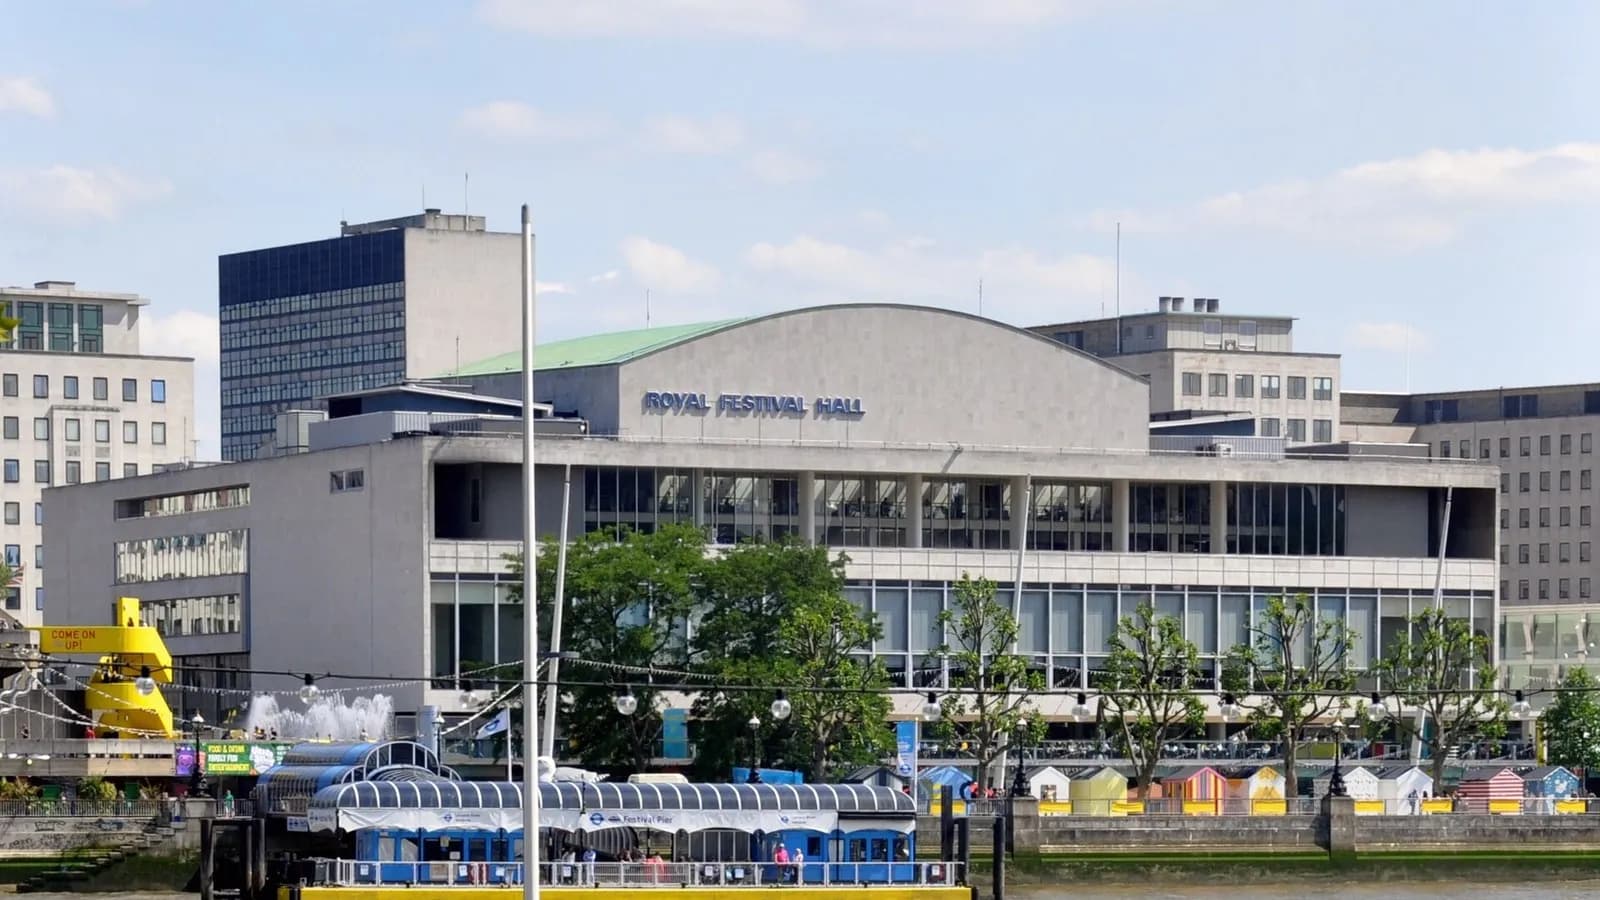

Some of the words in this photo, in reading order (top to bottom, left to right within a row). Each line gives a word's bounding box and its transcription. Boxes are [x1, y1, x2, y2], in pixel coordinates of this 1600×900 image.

[643, 391, 709, 413] ROYAL
[718, 393, 808, 415] FESTIVAL
[815, 397, 865, 415] HALL
[51, 630, 80, 639] COME
[82, 630, 96, 639] ON
[65, 640, 82, 650] UP!
[208, 745, 222, 753] FOOD
[228, 745, 245, 753] DRINK
[623, 814, 656, 824] Festival
[657, 814, 673, 824] Pier
